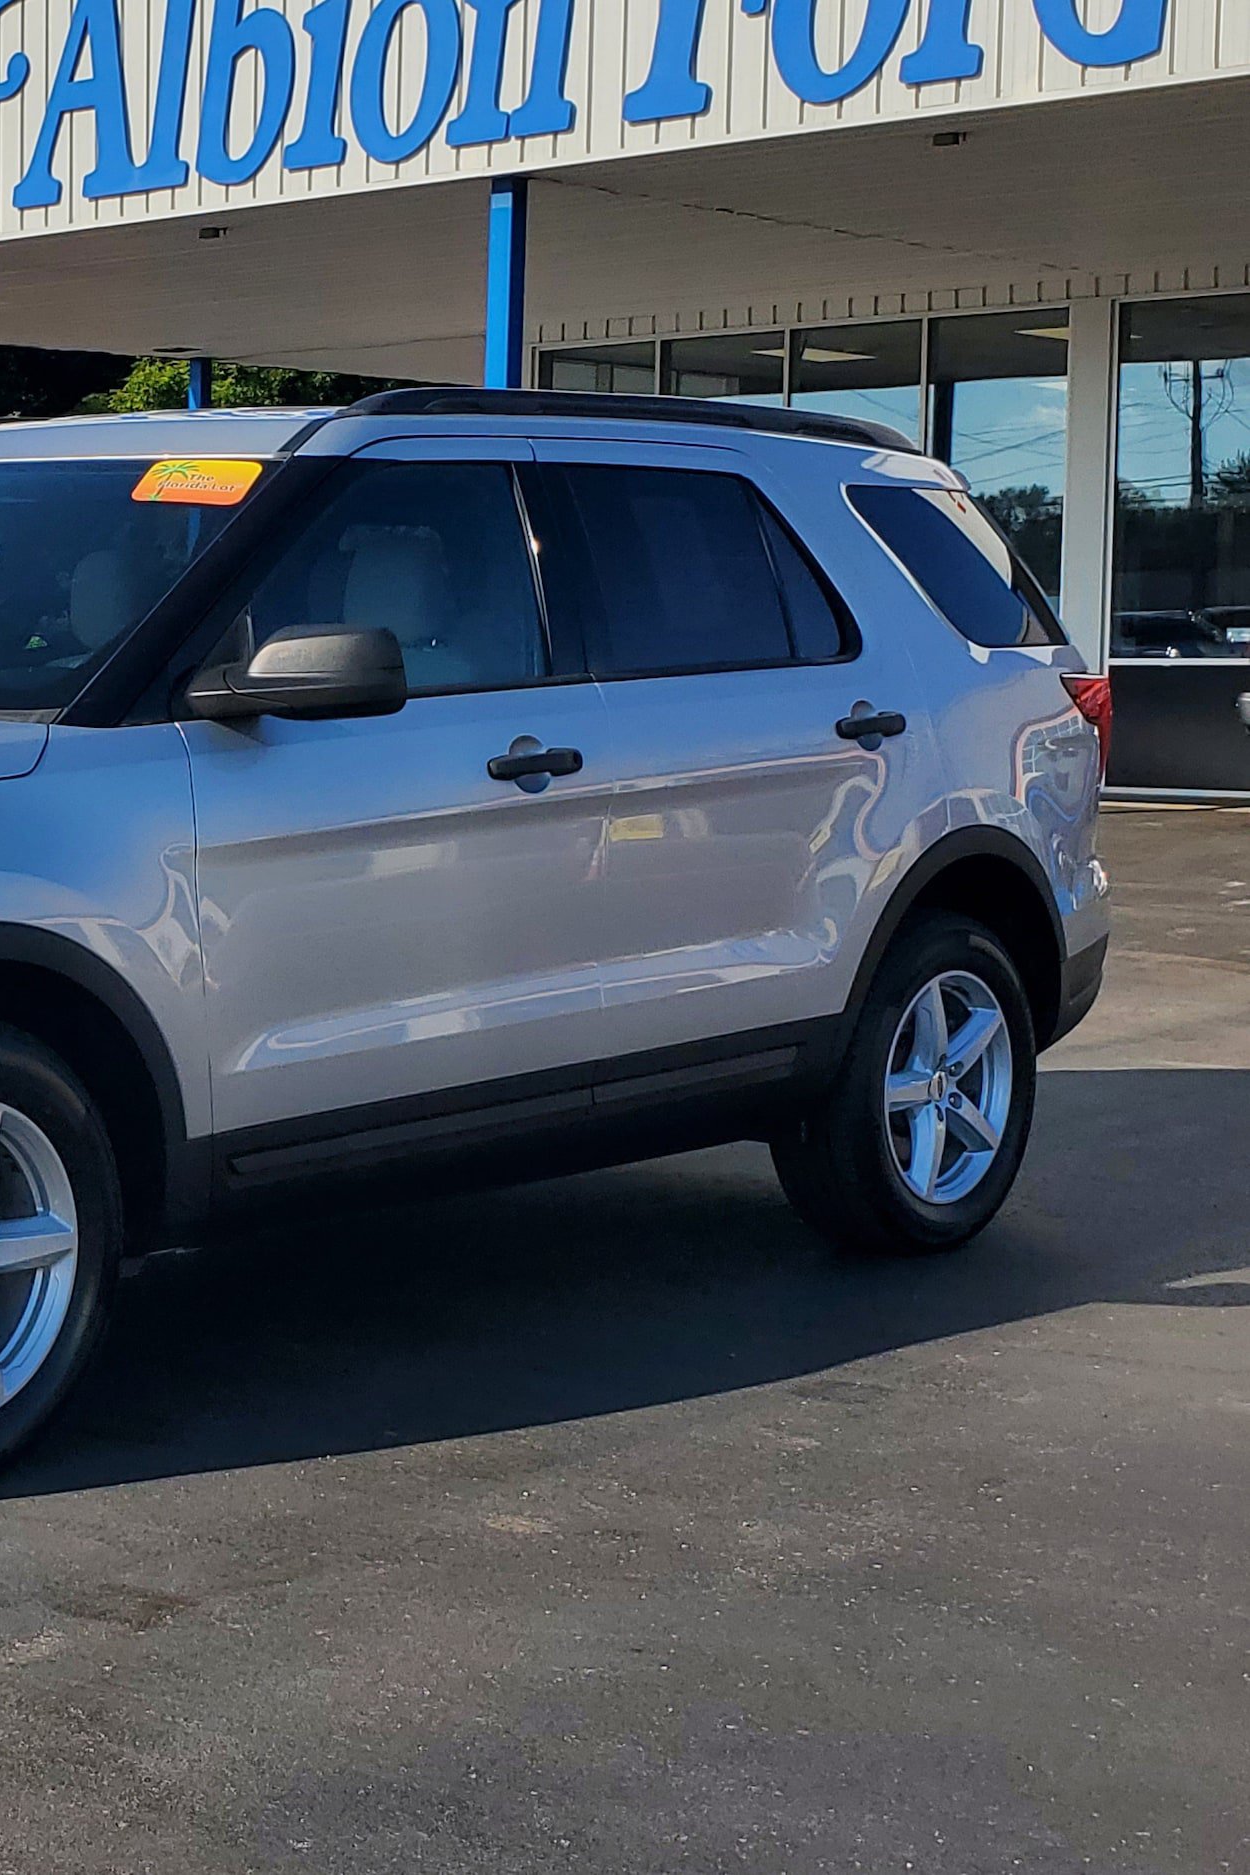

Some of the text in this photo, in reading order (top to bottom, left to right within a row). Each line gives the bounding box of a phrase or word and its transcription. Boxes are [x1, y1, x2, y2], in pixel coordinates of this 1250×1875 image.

[189, 473, 215, 482] The
[157, 479, 236, 493] Florida Lot
